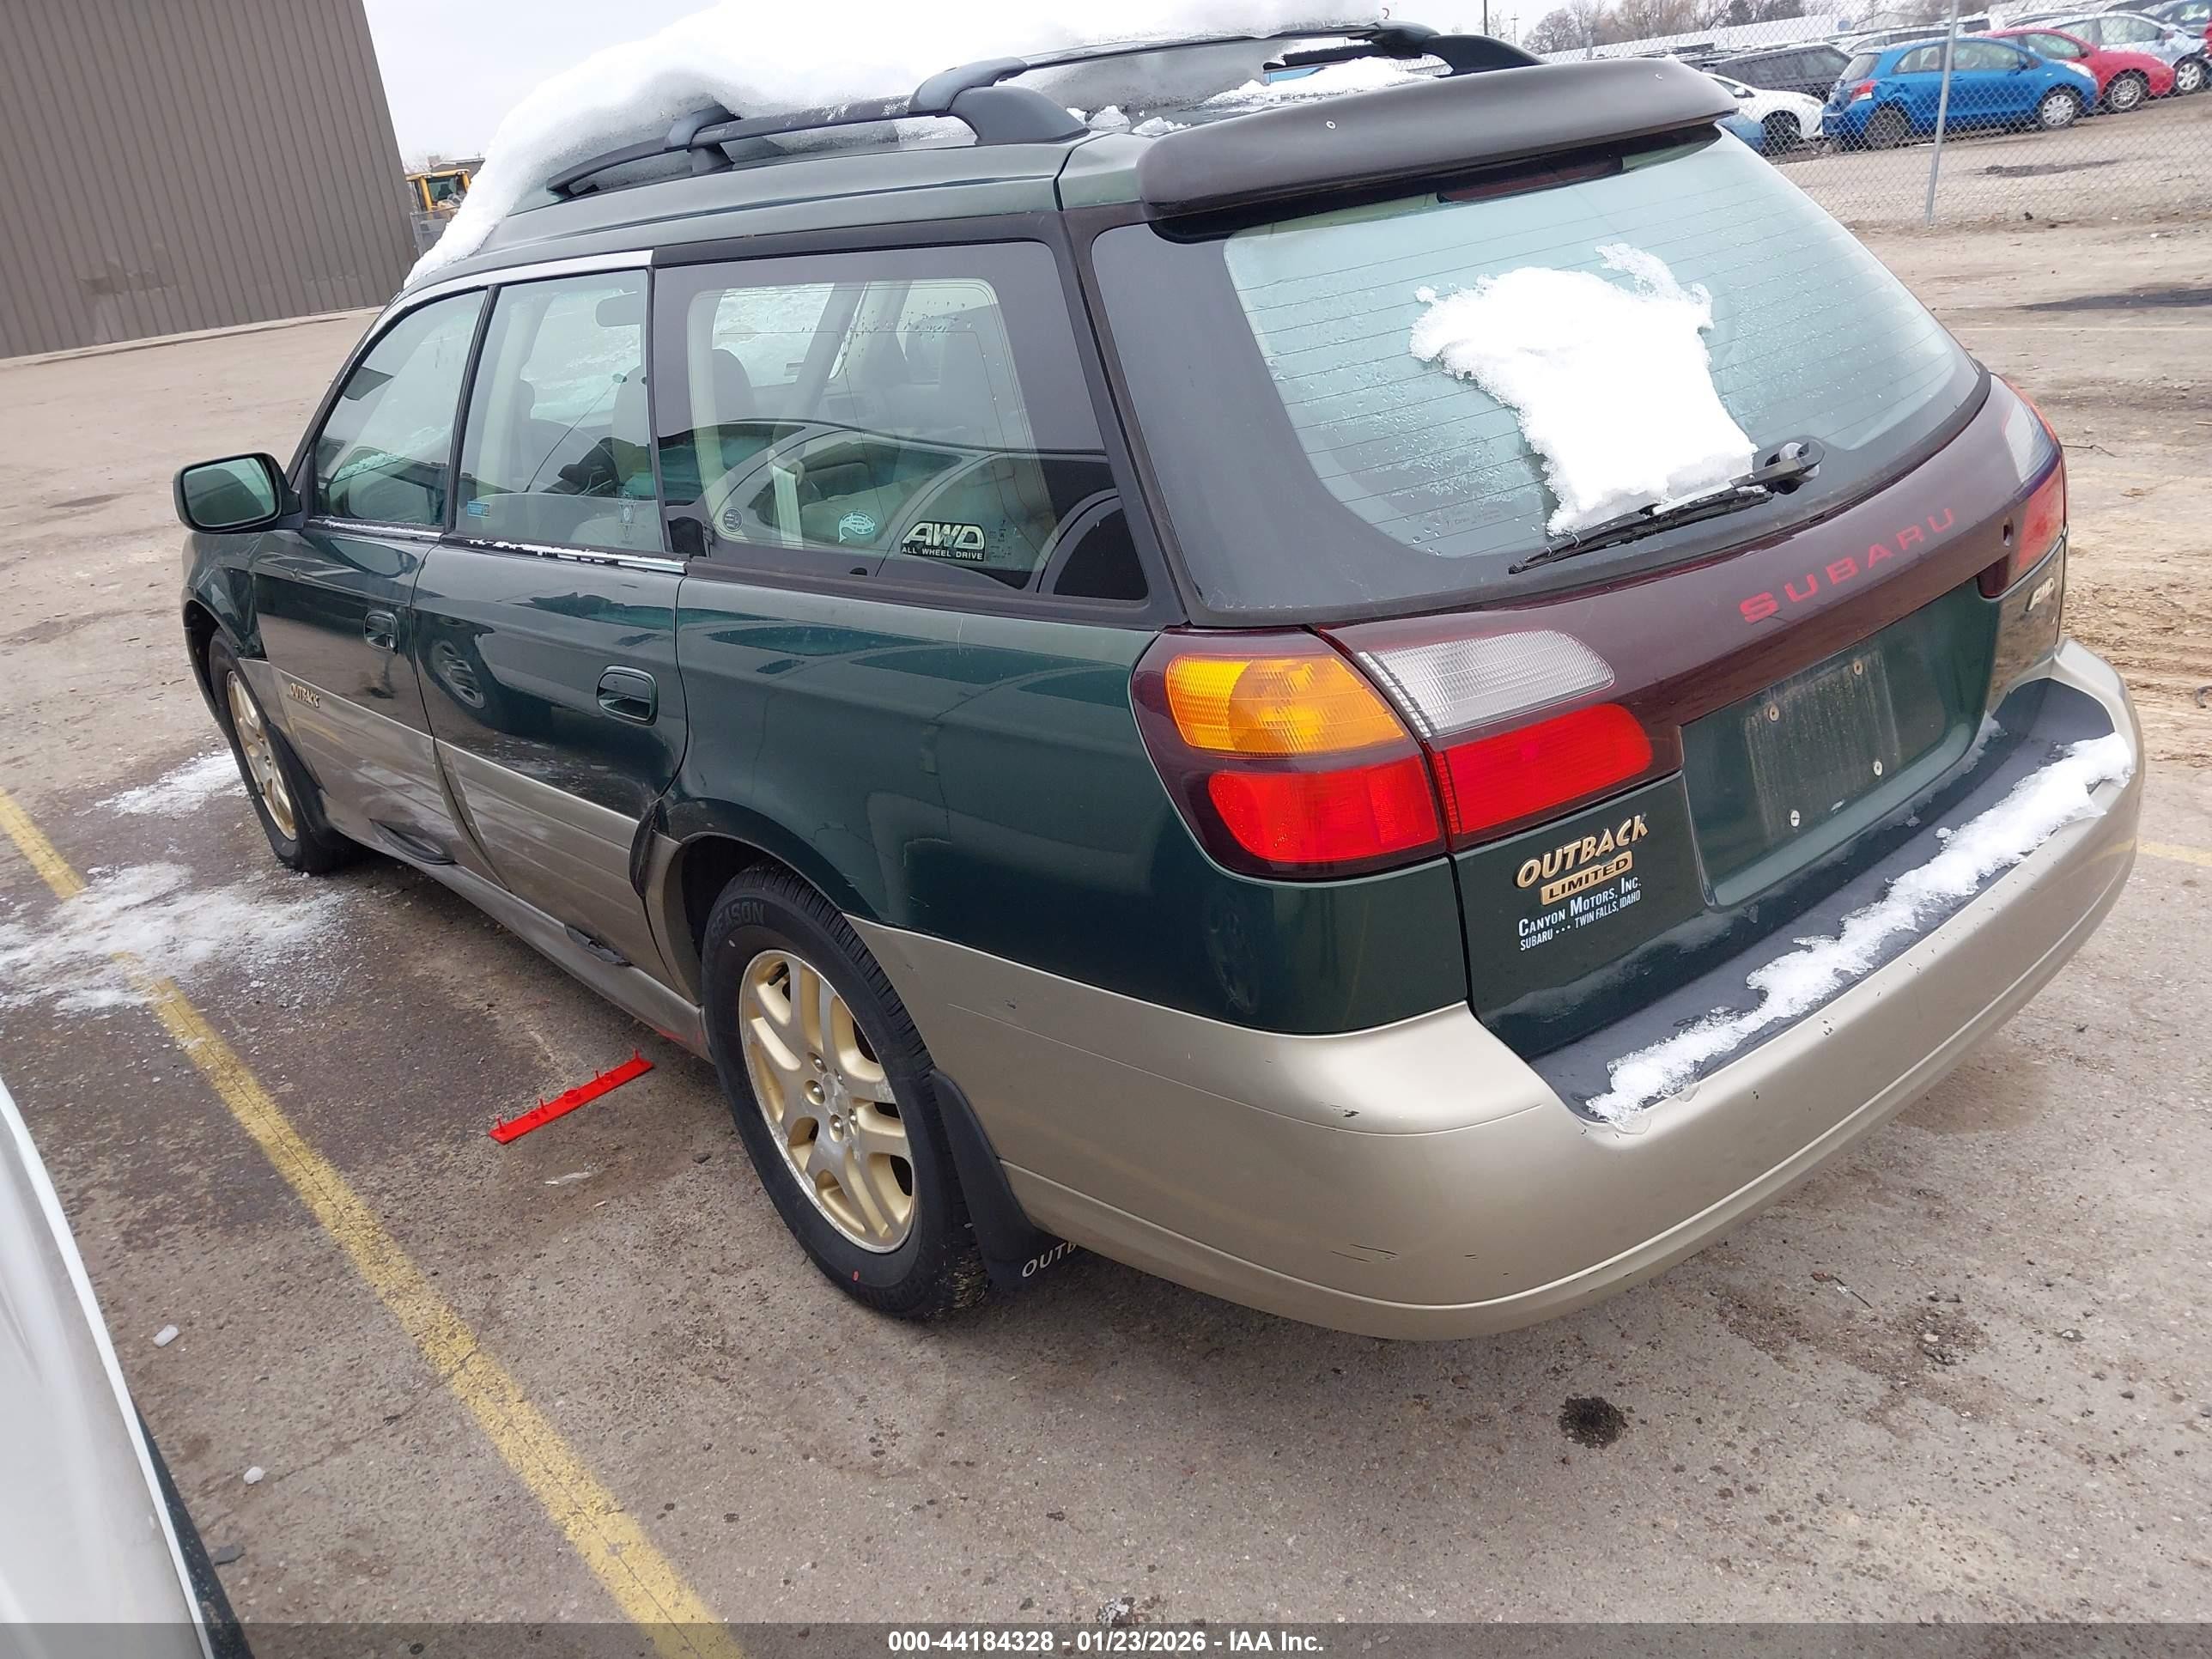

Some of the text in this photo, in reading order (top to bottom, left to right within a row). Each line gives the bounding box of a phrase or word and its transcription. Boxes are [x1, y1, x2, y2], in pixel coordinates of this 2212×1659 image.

[902, 522, 985, 550] AWD
[902, 546, 983, 560] ALL WHEEL DRIVE
[1739, 507, 1954, 623] SUBARU
[1516, 814, 1648, 888] OUTBACK
[1549, 858, 1629, 899] LIMITED
[1520, 890, 1641, 951] SUBARU TWIN FALLS, IDAHO
